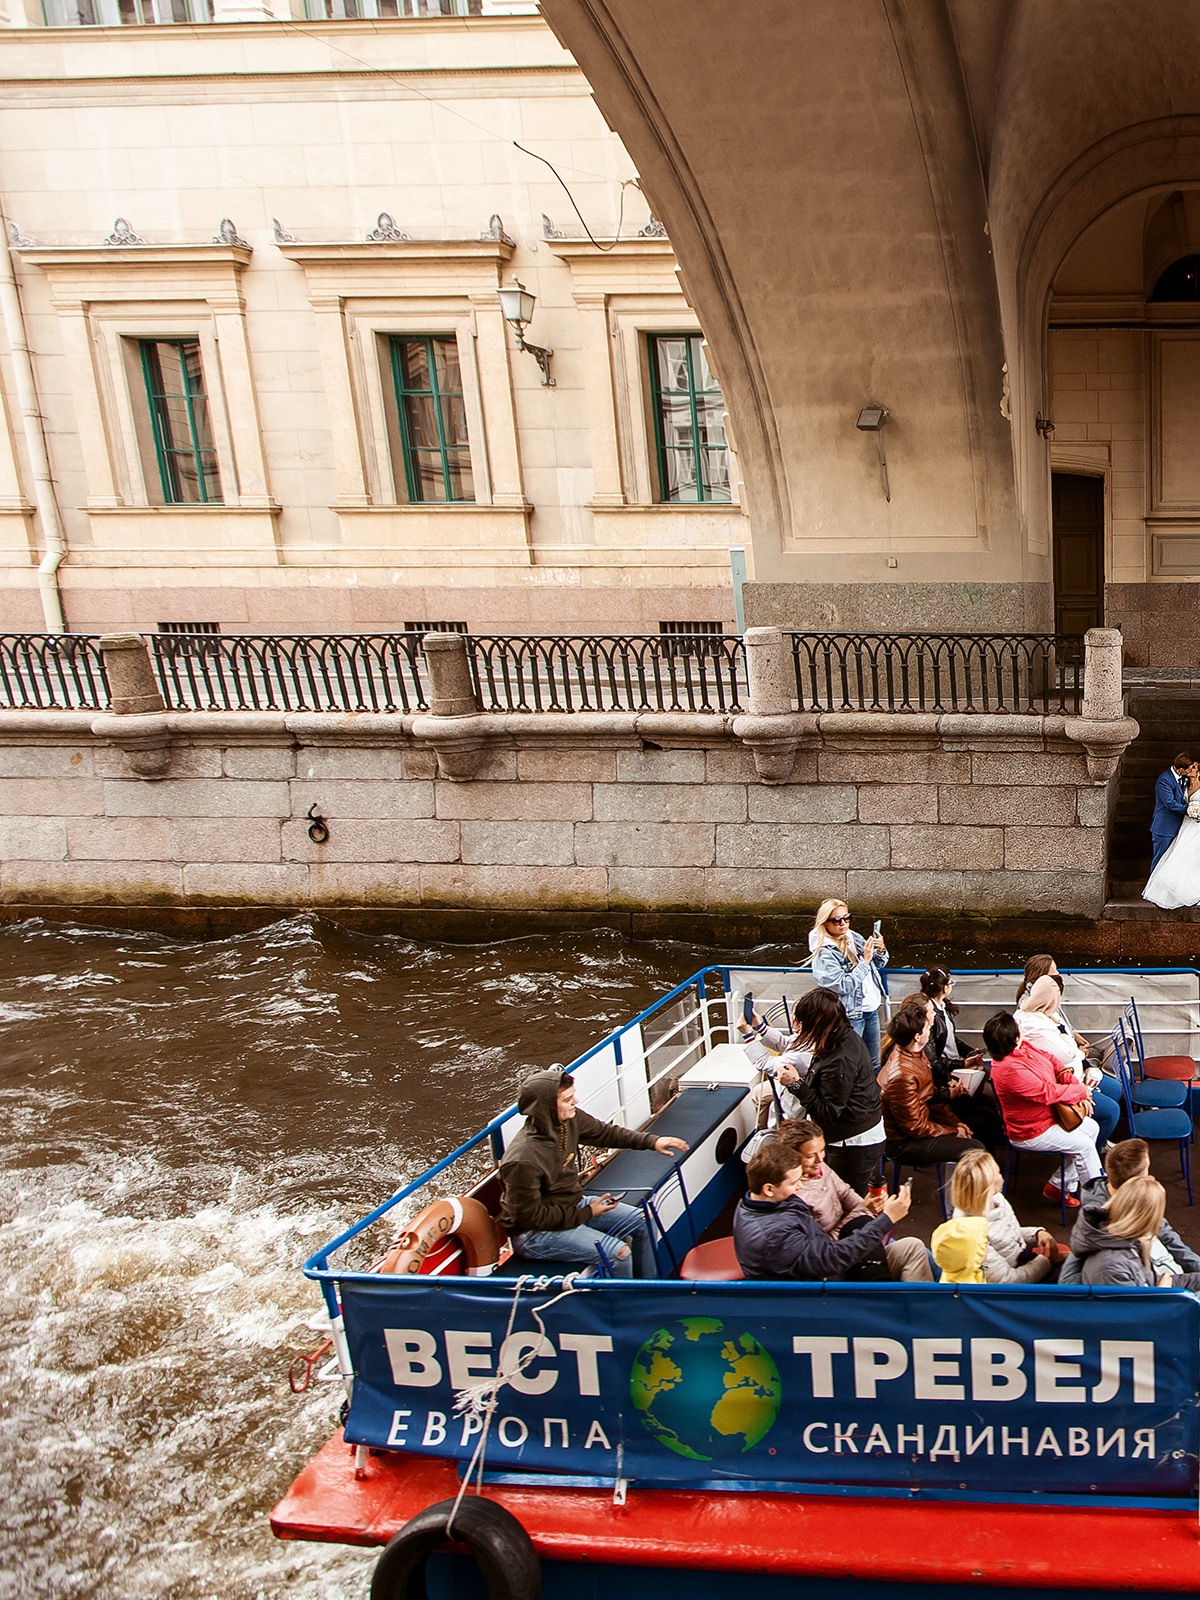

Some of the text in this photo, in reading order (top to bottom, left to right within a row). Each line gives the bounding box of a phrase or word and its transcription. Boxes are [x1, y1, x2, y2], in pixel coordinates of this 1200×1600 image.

[383, 1328, 1156, 1404] ВЕСТ ТРЕВЕЛ
[386, 1409, 1156, 1463] ЕВРОПА СКАНДИНАВИЯ
